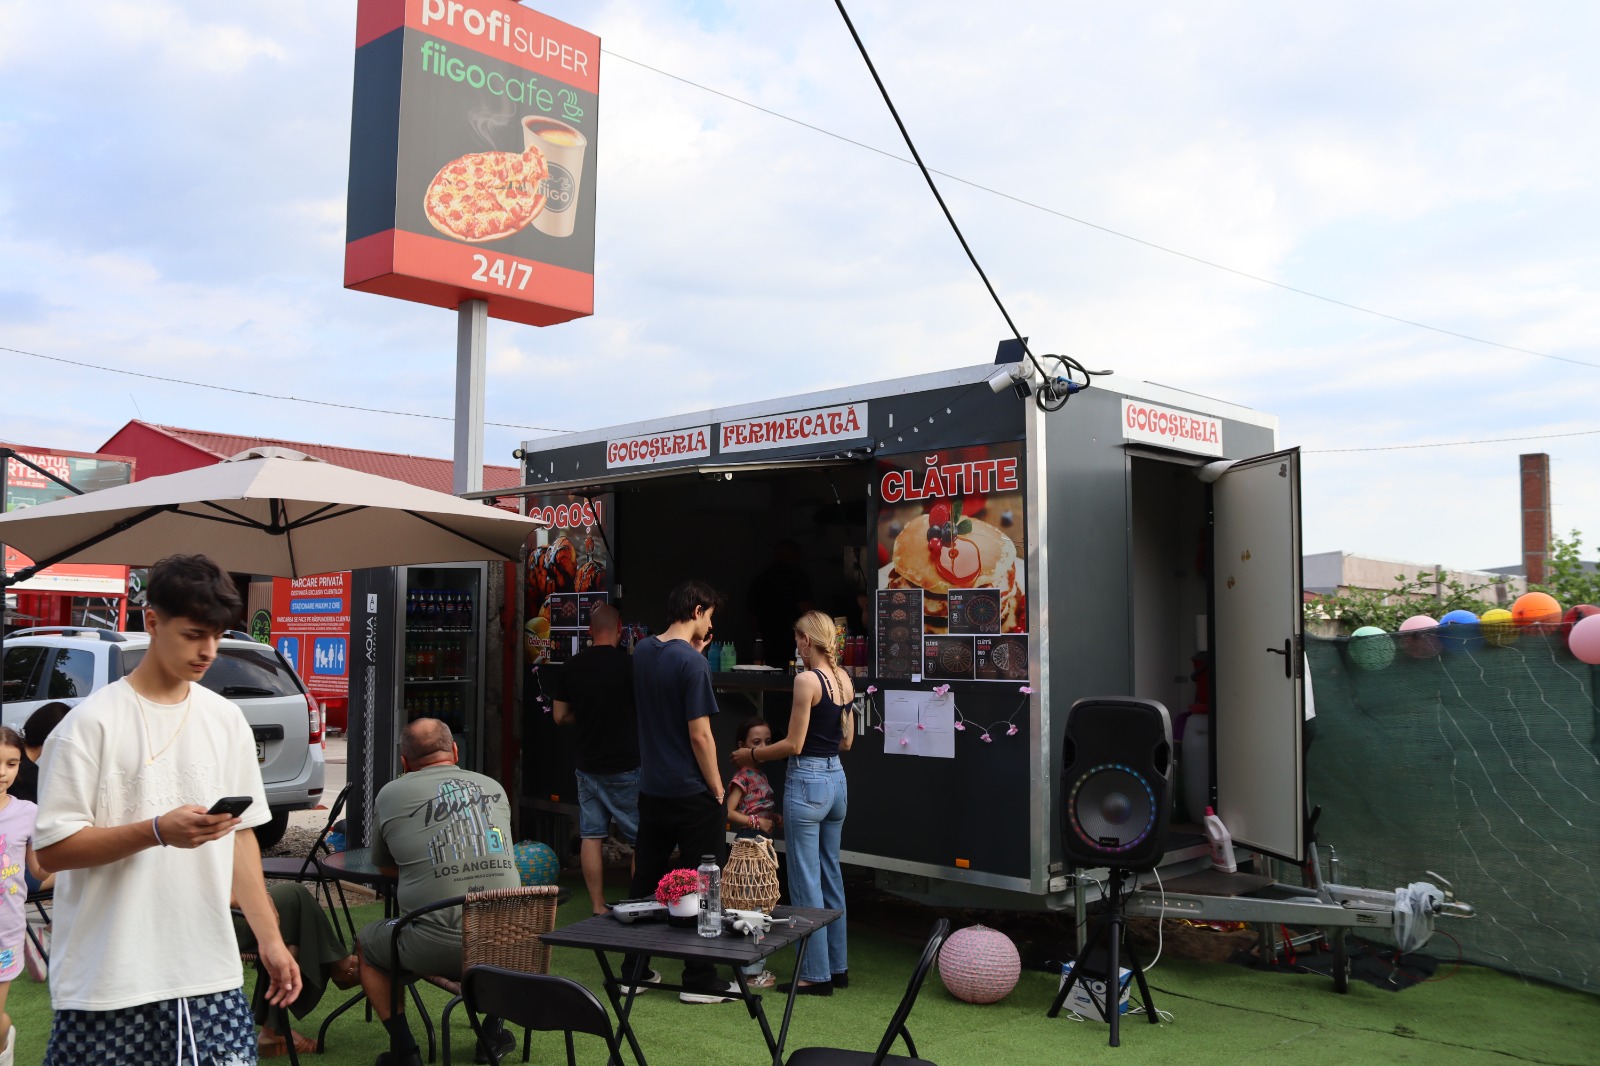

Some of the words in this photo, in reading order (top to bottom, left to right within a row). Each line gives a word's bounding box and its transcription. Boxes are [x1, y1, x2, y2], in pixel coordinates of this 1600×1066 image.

[471, 254, 533, 290] 24/7
[722, 405, 861, 448] FERMECATĂ
[880, 454, 1018, 503] CLĂTITE
[291, 577, 318, 588] PARCARE
[319, 574, 343, 587] PRIVATĂ
[366, 616, 374, 662] AQUA
[490, 833, 500, 849] 3
[434, 865, 460, 879] LOS
[462, 859, 512, 873] ANGELES
